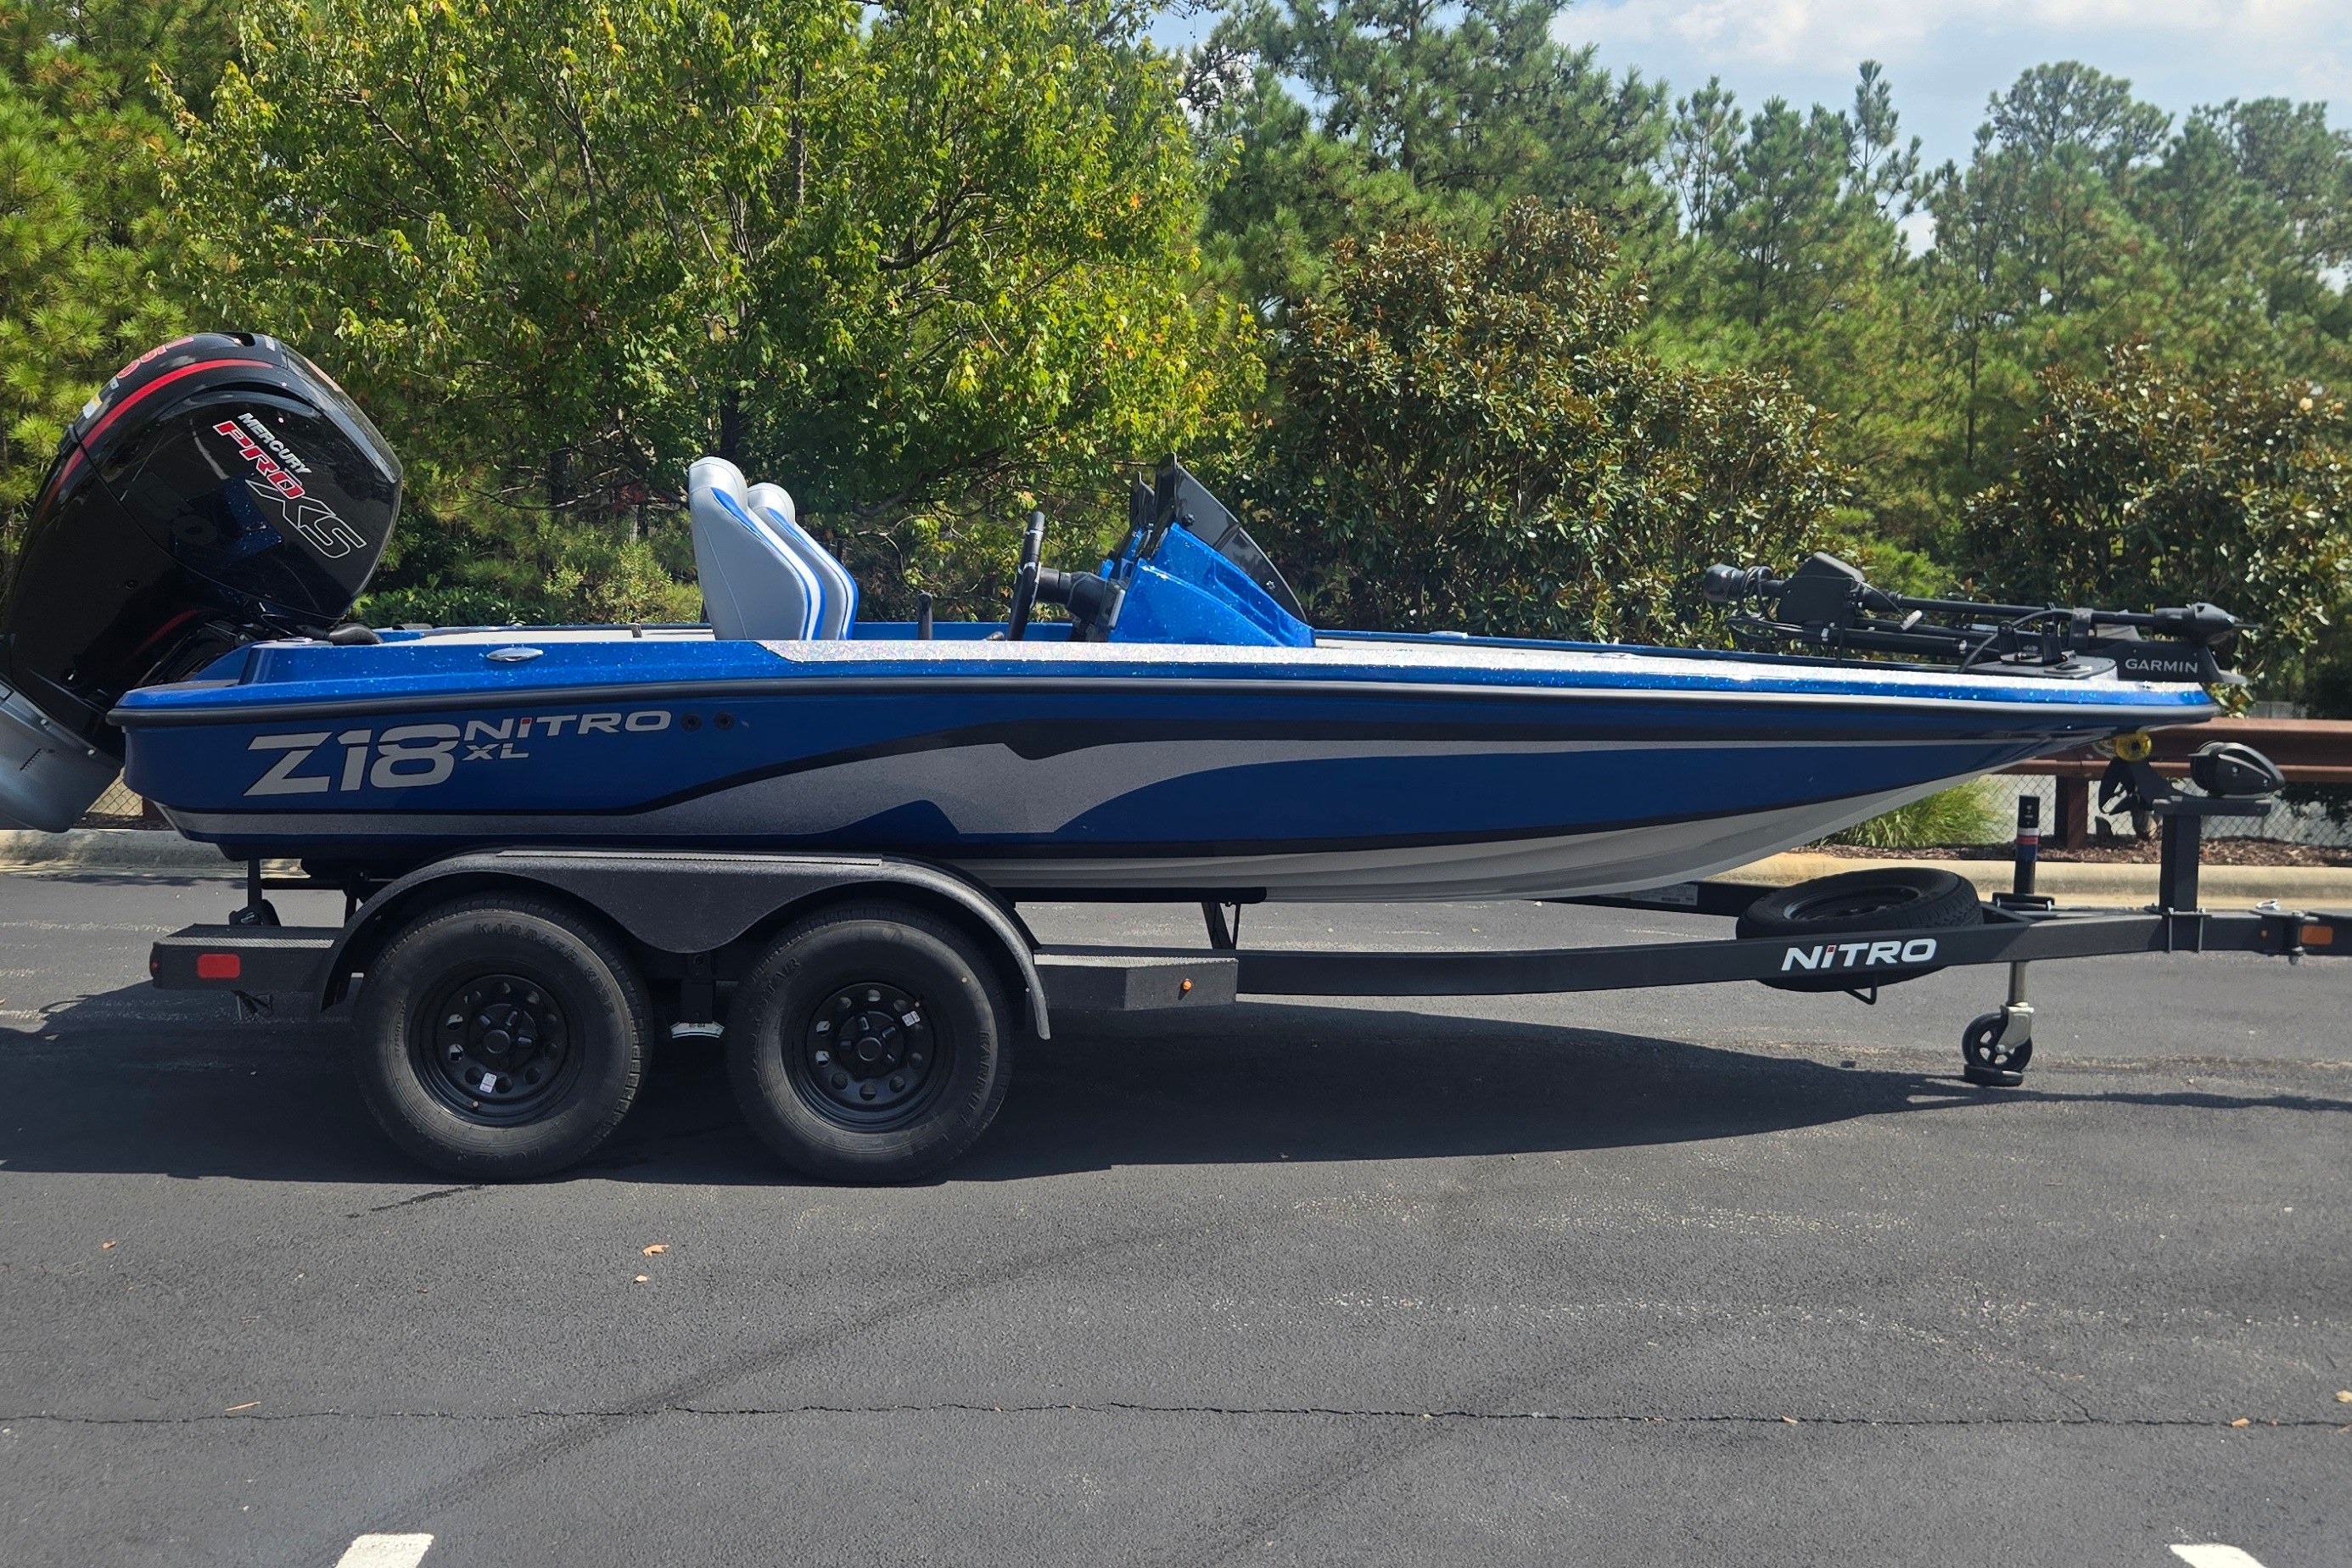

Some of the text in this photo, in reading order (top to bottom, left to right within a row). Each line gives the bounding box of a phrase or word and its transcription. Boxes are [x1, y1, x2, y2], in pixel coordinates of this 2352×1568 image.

[212, 420, 305, 500] PRO
[238, 412, 312, 473] MERCURY
[245, 468, 367, 558] XS
[2125, 658, 2198, 674] GARMIN
[243, 722, 461, 797] Z18
[461, 742, 530, 761] XL
